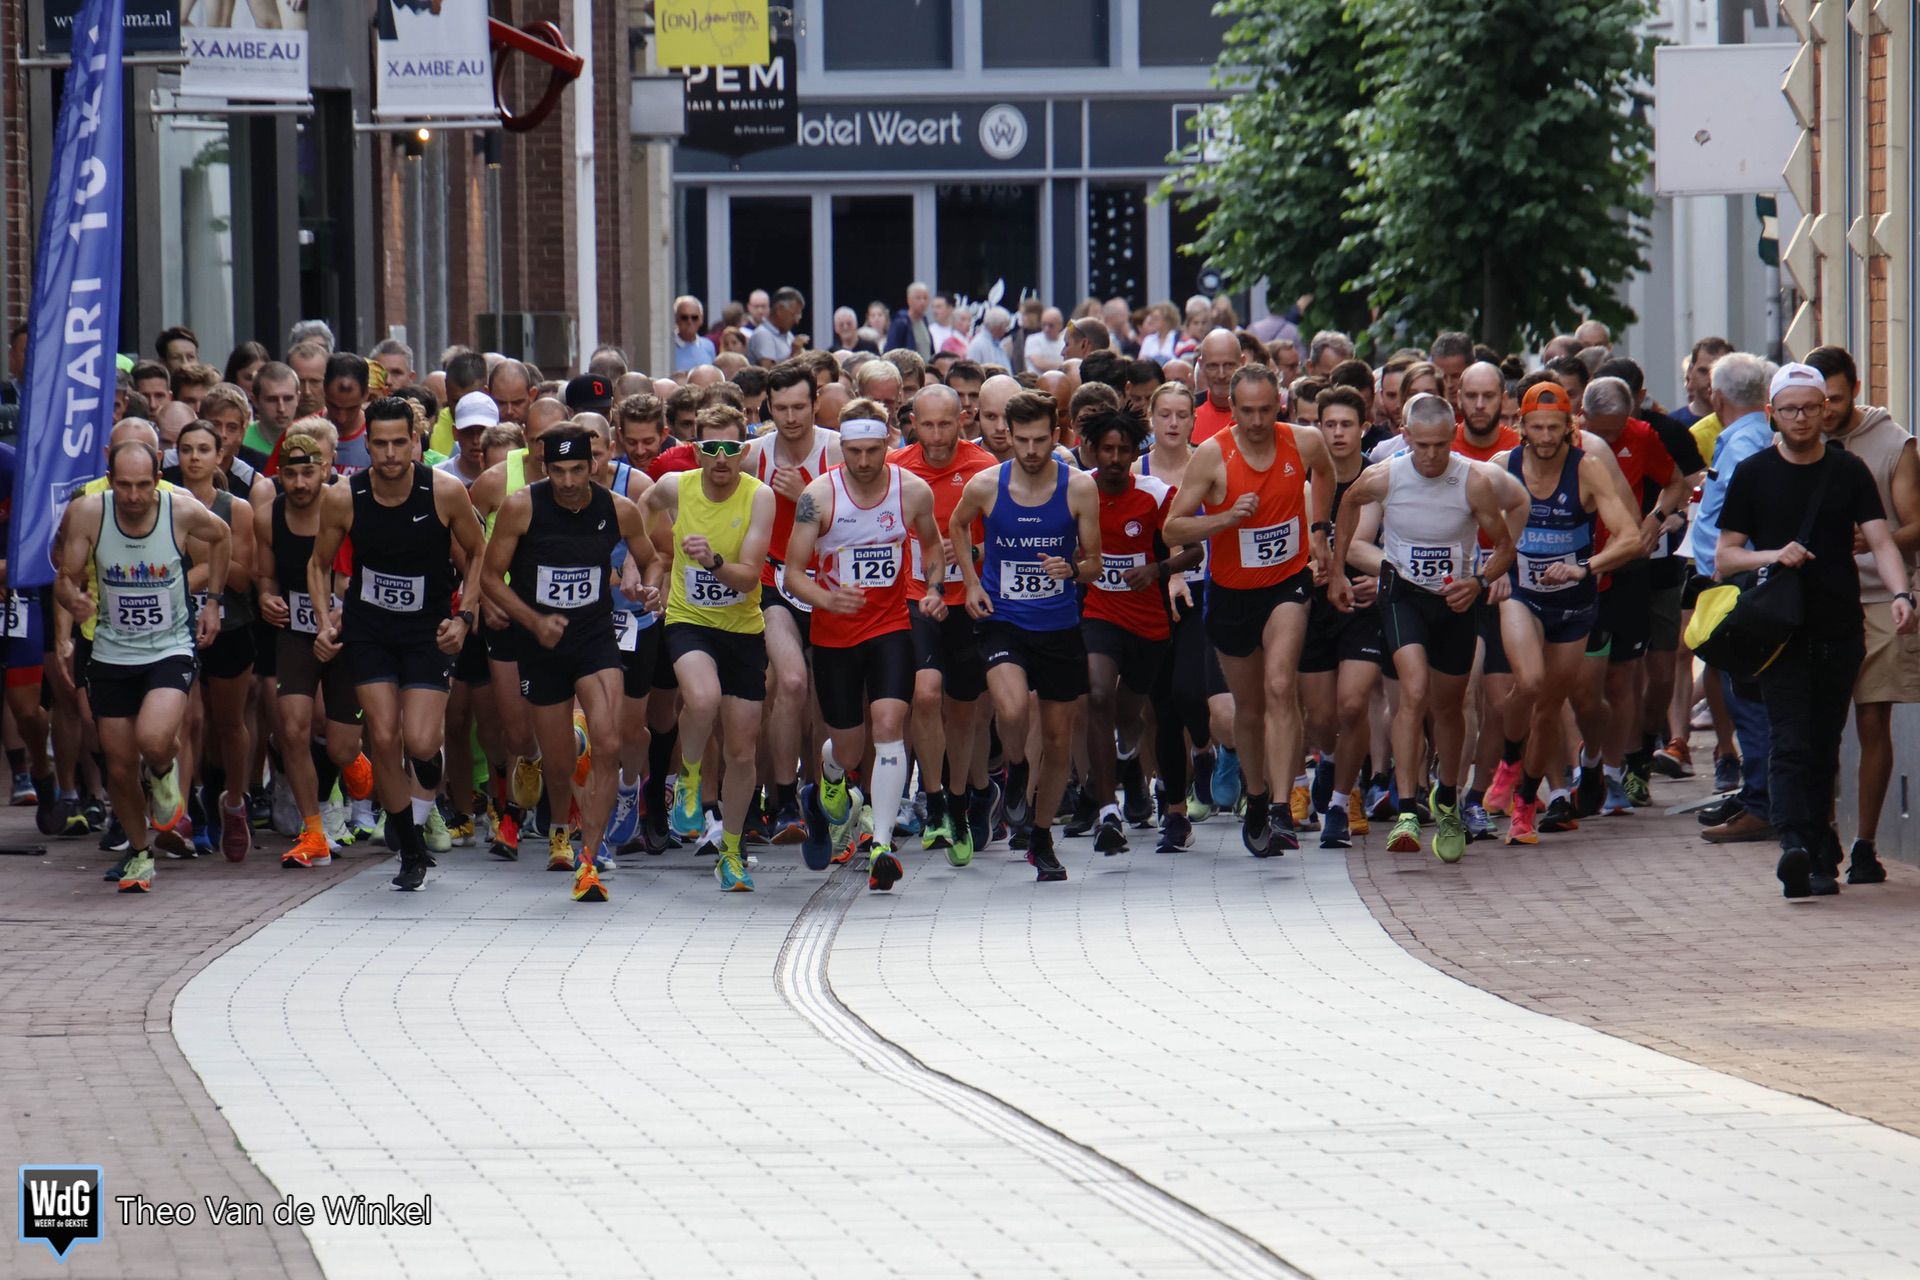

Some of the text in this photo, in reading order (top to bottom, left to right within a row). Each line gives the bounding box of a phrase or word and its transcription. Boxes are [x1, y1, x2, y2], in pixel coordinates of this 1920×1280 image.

[192, 39, 300, 60] XAMBEAU
[387, 60, 485, 77] XAMBEAU
[682, 56, 785, 93] PEM
[730, 99, 785, 111] MAKE-UP
[867, 110, 962, 146] Weert
[995, 535, 1065, 548] A.V. WEERT
[1527, 531, 1574, 544] BAENS
[1257, 538, 1288, 560] 52
[851, 560, 896, 580] 126
[548, 581, 592, 601] 219
[692, 583, 739, 601] 364
[1010, 574, 1057, 592] 383
[373, 584, 416, 606] 159
[118, 607, 164, 626] 255
